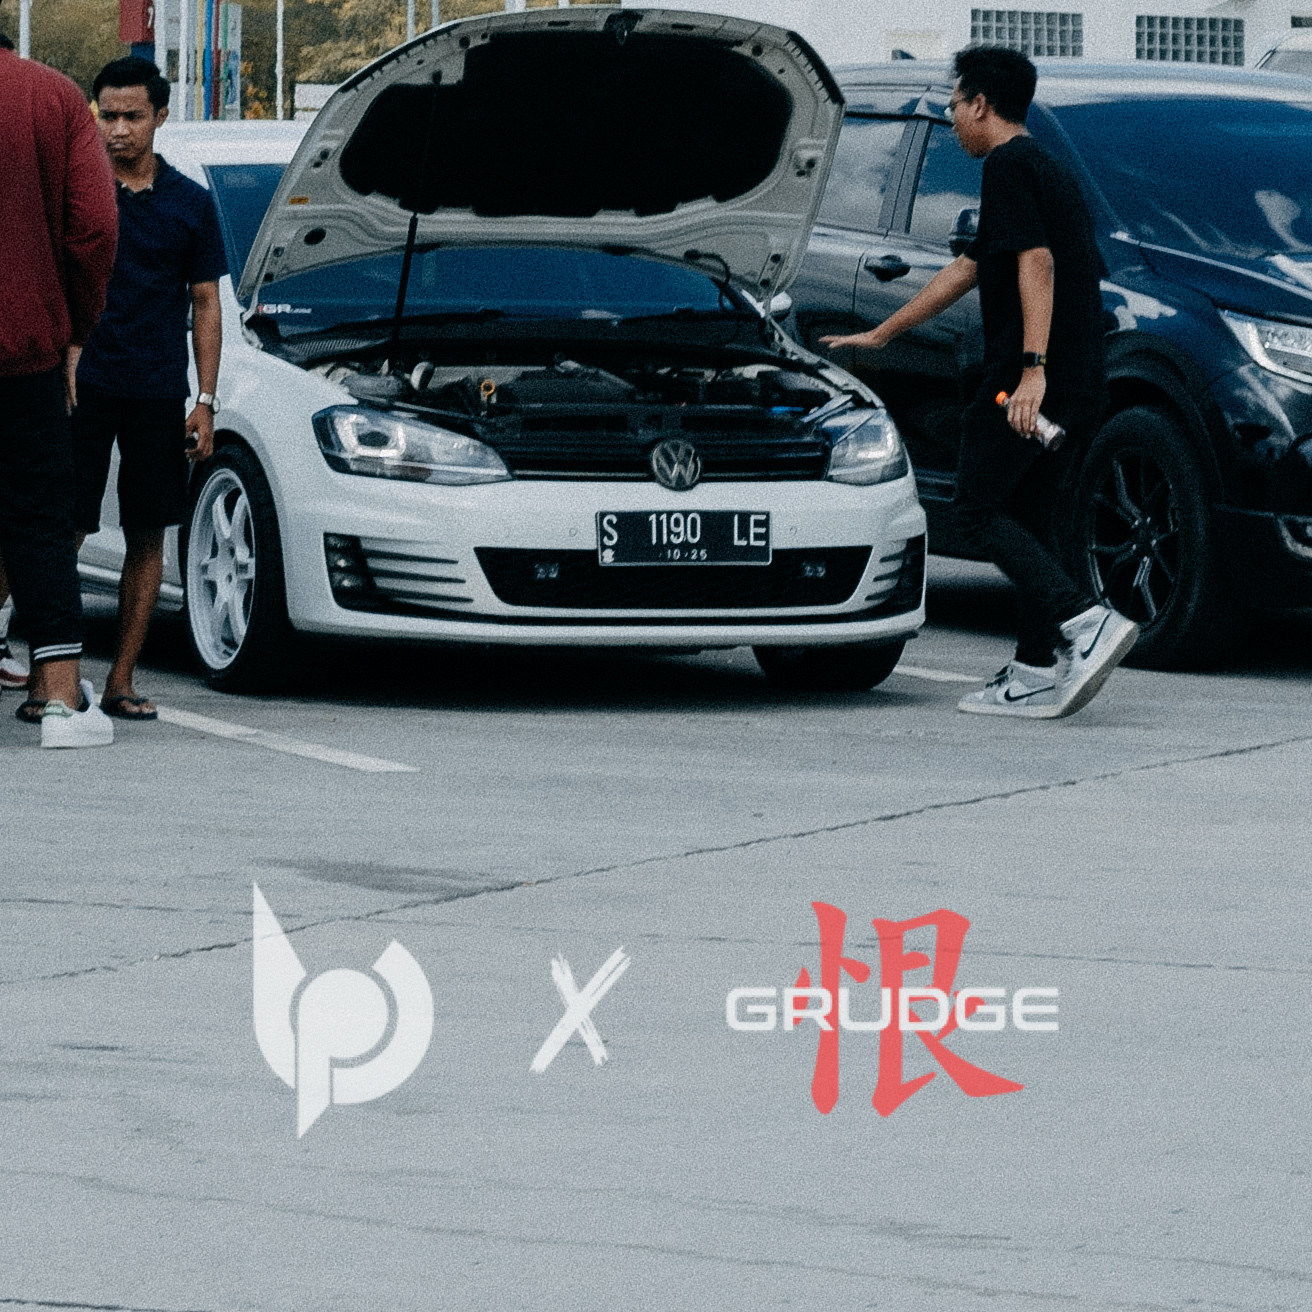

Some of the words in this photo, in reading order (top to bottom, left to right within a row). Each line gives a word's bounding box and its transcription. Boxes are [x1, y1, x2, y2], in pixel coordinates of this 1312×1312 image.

[602, 514, 619, 546] S
[648, 512, 702, 546] 1190
[733, 514, 767, 546] LE
